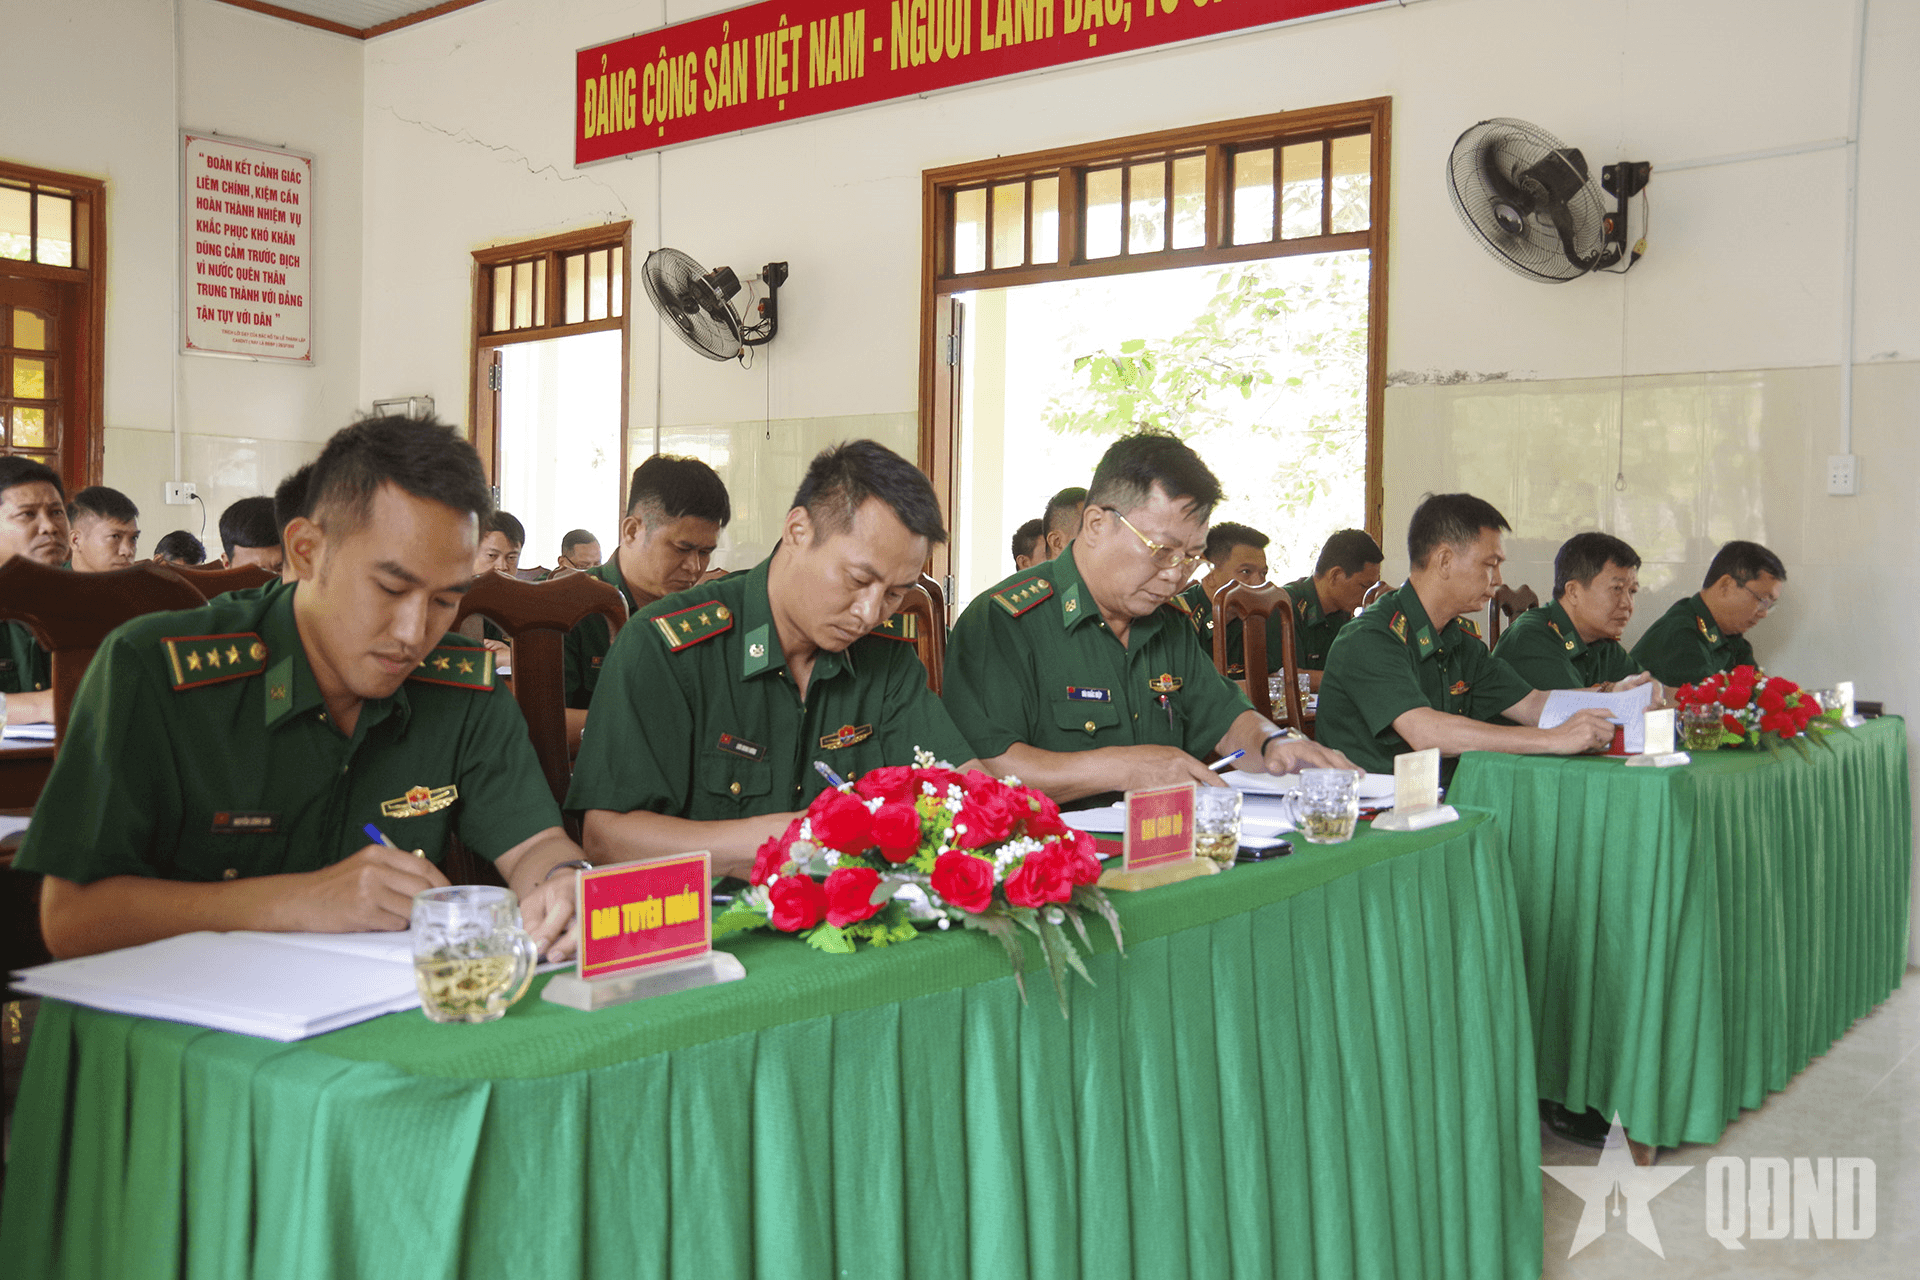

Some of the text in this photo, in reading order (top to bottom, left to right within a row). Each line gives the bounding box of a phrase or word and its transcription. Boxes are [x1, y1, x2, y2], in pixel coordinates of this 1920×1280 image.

[584, 53, 636, 139] ĐẢNG
[642, 46, 697, 137] CỘNG
[703, 20, 748, 113] SẢN
[755, 13, 802, 111] VIỆT
[808, 9, 865, 89] NAM
[235, 158, 251, 175] KẾT
[254, 161, 278, 180] CẢNH
[281, 168, 301, 184] GIÁC
[196, 175, 219, 192] LIÊM
[255, 186, 277, 202] KIỆM
[196, 196, 301, 228] HOÀN THÀNH NHIỆM VỤ
[196, 217, 221, 235] KHẮC
[224, 224, 248, 240] PHỤC
[251, 227, 269, 242] KHÓ
[196, 240, 300, 269] DŨNG CẢM TRƯỚC ĐỊCH
[197, 260, 206, 275] VÌ
[208, 261, 233, 278] NƯỚC
[236, 266, 260, 282] QUÊN
[197, 282, 227, 298] TRUNG
[230, 285, 259, 302] THÀNH
[262, 288, 276, 304] VỚI
[196, 305, 215, 322] TẬN
[217, 309, 234, 324] TỤY
[236, 308, 251, 325] VỚI
[254, 311, 272, 327] DÂN
